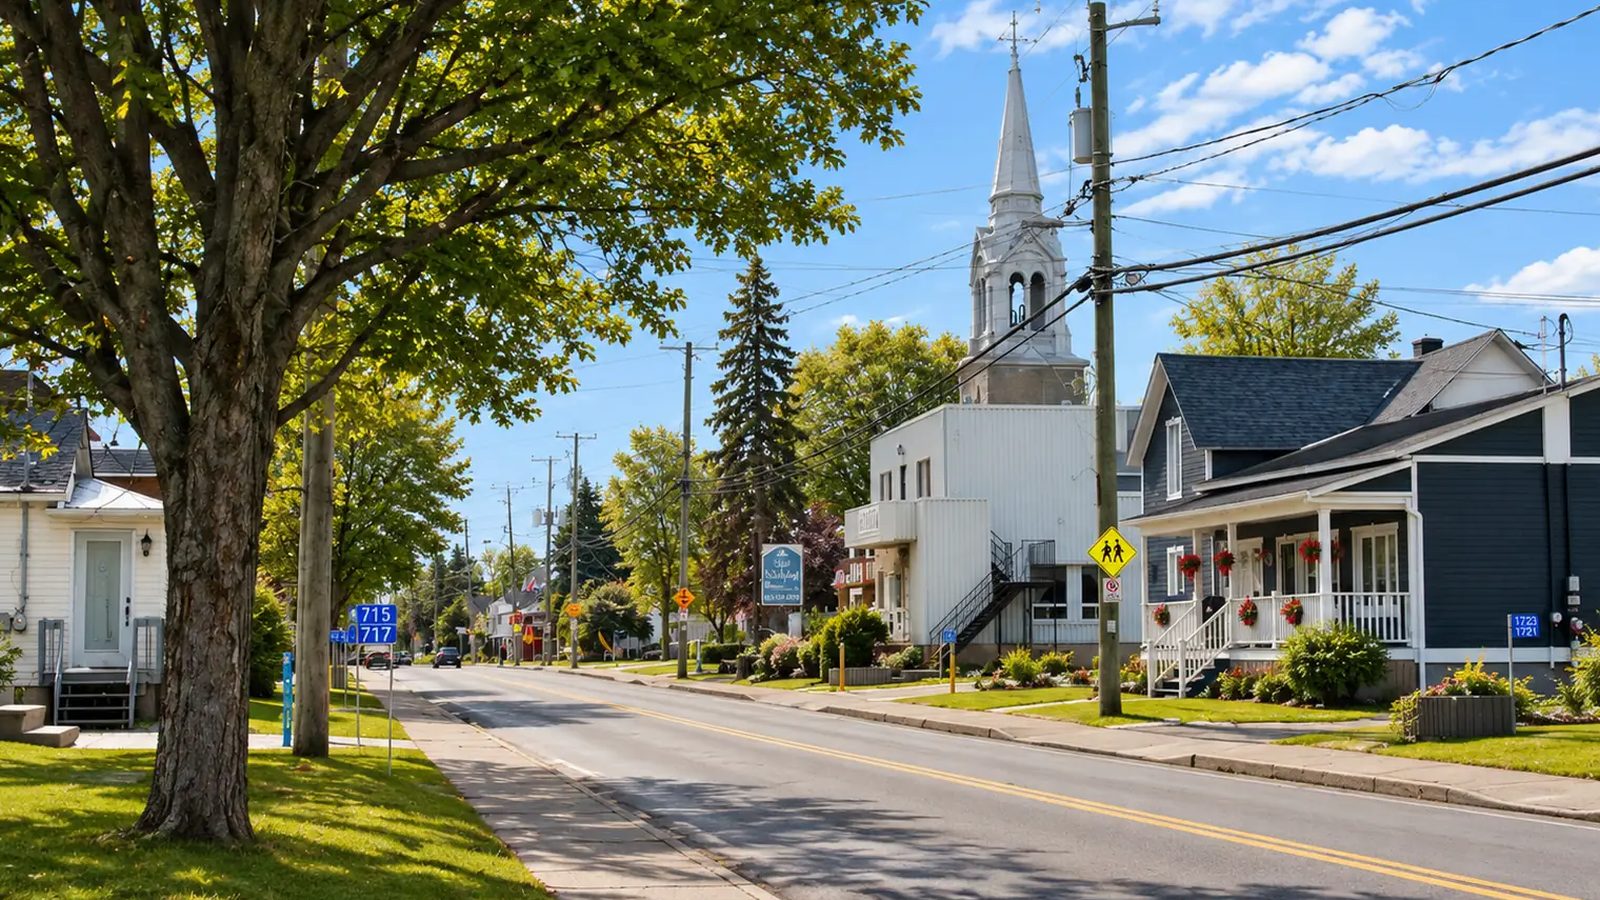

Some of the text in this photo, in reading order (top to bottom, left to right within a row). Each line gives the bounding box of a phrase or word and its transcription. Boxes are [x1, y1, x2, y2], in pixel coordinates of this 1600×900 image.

[361, 606, 391, 622] 715
[1514, 615, 1538, 626] 1723
[360, 626, 392, 642] 717
[1515, 626, 1537, 637] 1721
